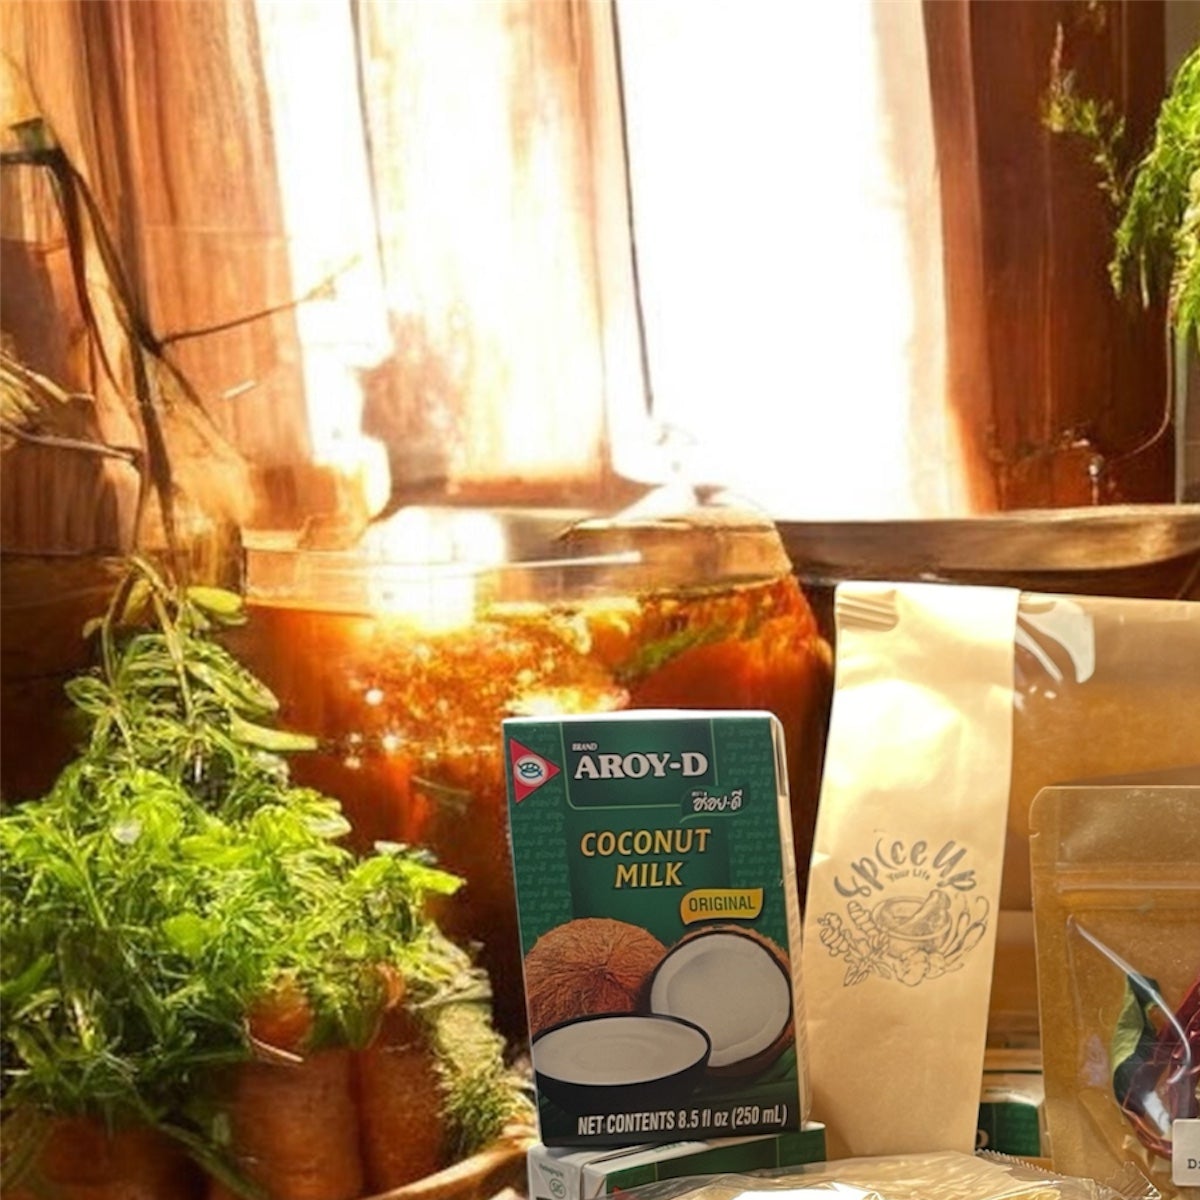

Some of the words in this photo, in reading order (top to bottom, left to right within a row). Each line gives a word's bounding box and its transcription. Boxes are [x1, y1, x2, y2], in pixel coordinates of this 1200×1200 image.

[572, 743, 598, 751] BRAND
[574, 752, 708, 780] AROY-D
[580, 828, 712, 856] COCONUT
[614, 862, 684, 888] MILK
[688, 896, 756, 912] ORIGINAL
[577, 1115, 604, 1135] NET
[606, 1110, 675, 1134] CONTENTS
[678, 1108, 699, 1128] 8.5
[702, 1108, 711, 1127] fl
[714, 1111, 729, 1127] oz
[731, 1106, 759, 1129] (250
[762, 1104, 788, 1126] mL)
